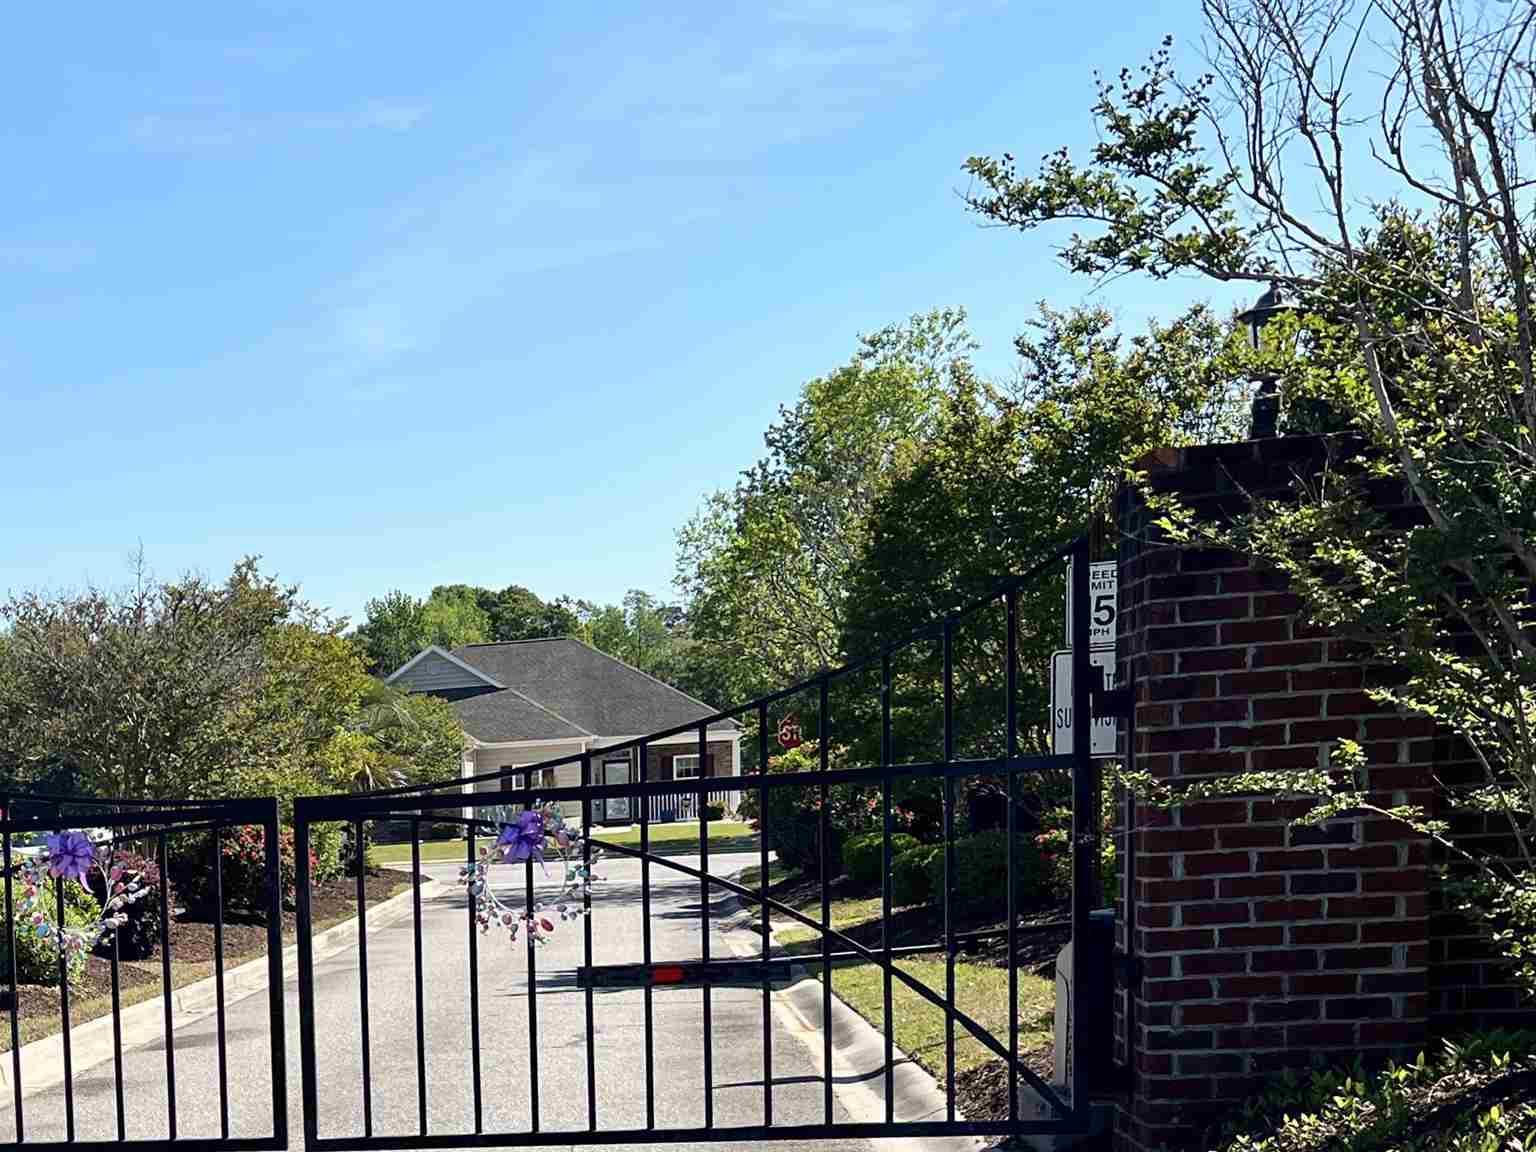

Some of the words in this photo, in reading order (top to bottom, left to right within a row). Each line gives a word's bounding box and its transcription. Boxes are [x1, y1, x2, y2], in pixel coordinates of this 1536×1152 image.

[1091, 569, 1117, 580] EED
[1091, 580, 1115, 590] MIT
[1093, 595, 1116, 626] 5
[1091, 627, 1110, 637] PH
